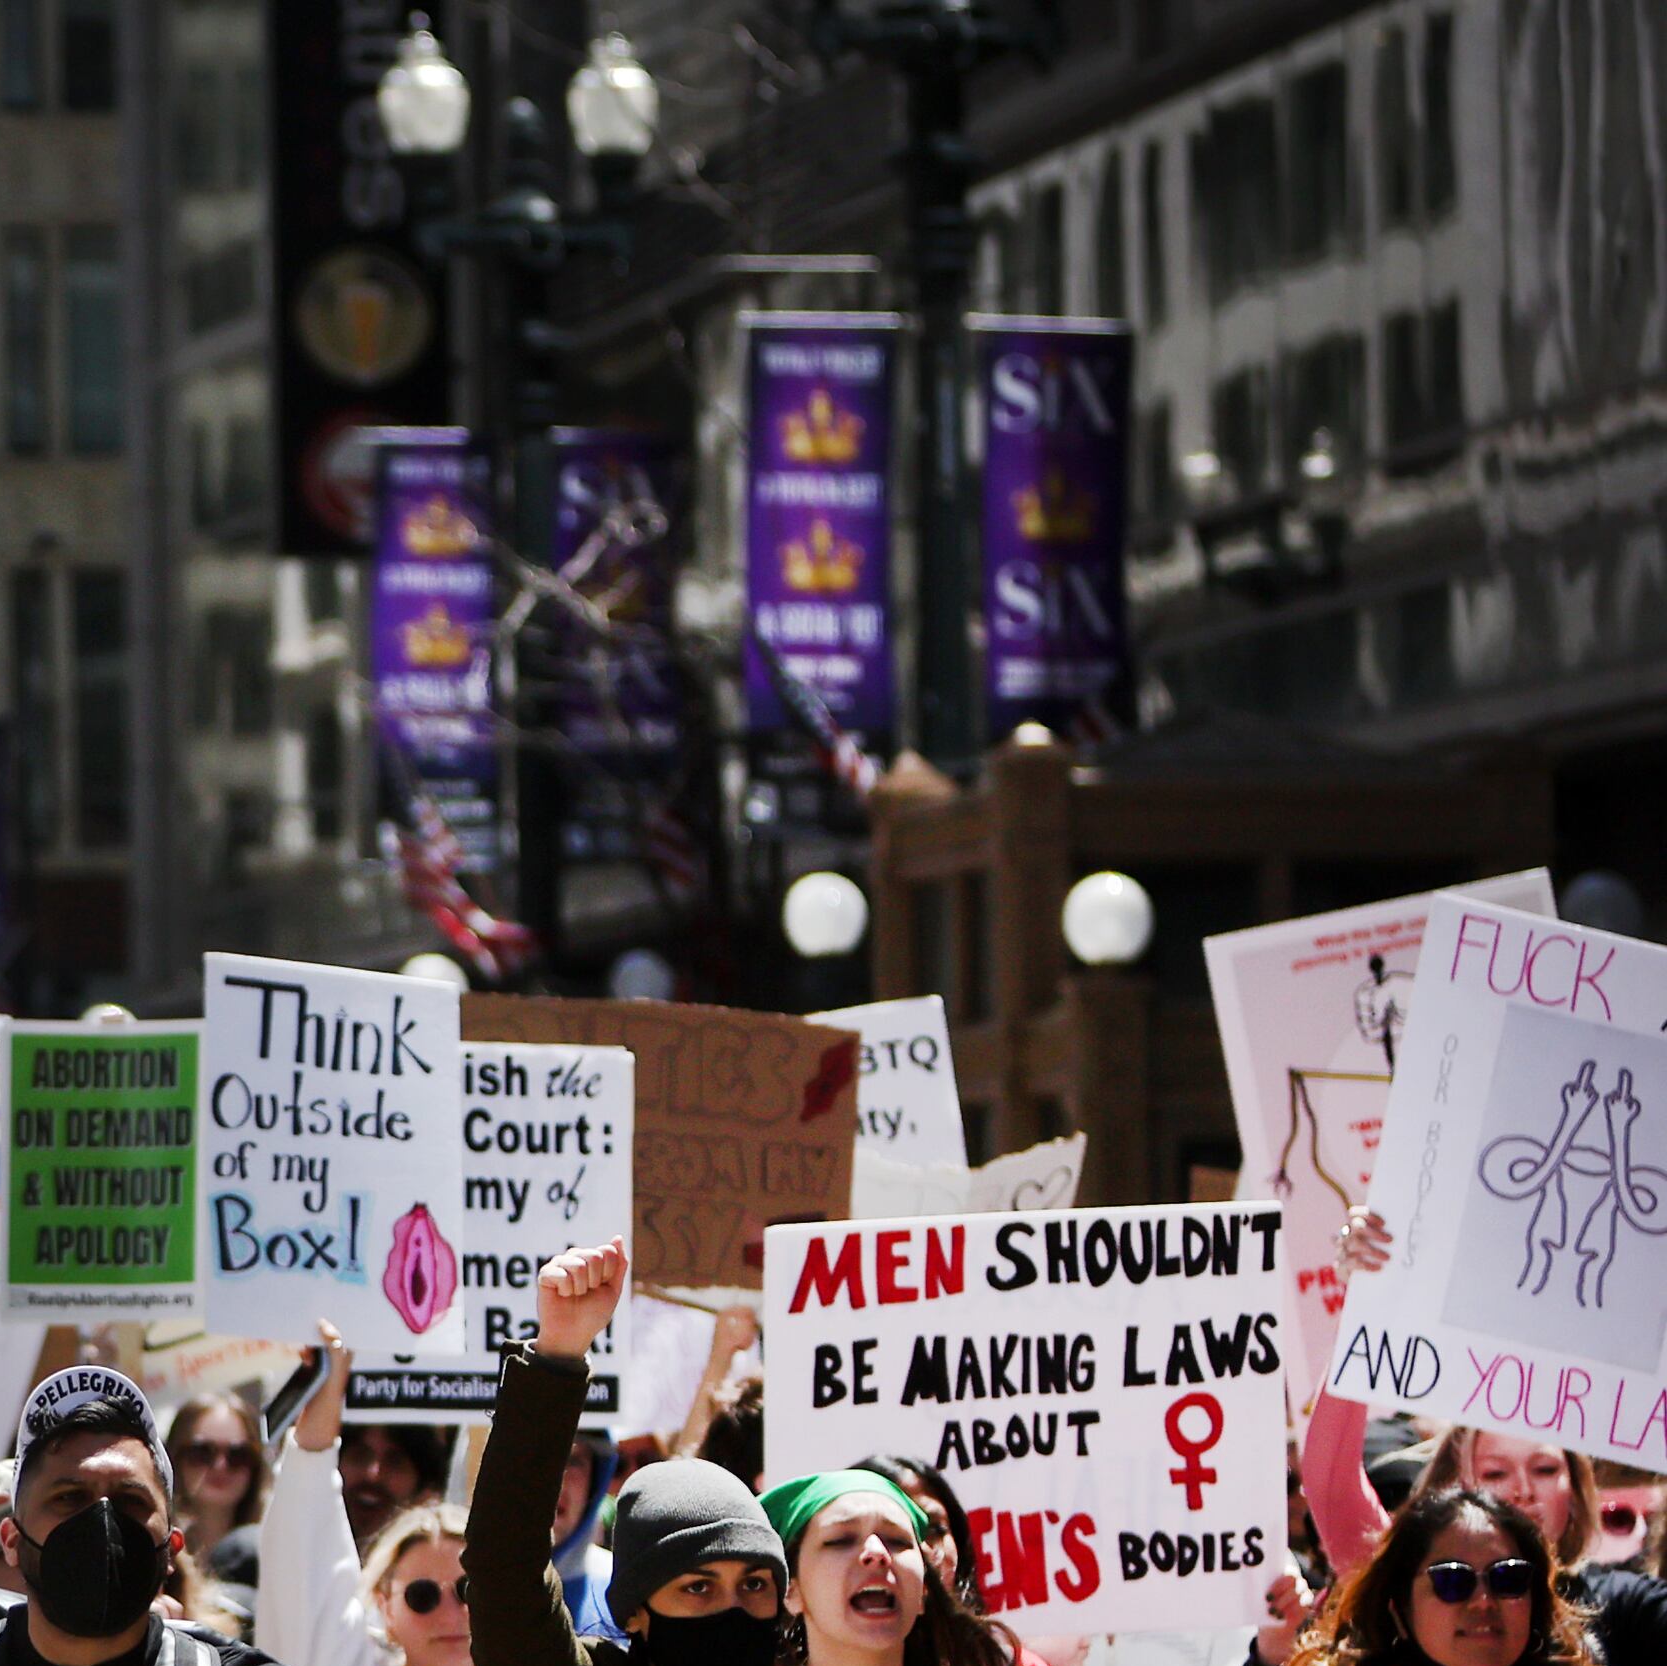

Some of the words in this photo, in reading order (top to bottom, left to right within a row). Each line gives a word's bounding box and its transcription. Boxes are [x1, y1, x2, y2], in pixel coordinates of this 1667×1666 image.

[1451, 913, 1616, 1021] FUCK
[224, 975, 433, 1076] Think
[31, 1049, 177, 1089] ABORTION
[545, 1056, 603, 1099] the
[17, 1109, 54, 1148] ON
[66, 1107, 193, 1148] DEMAND
[212, 1070, 414, 1141] Outside
[24, 1172, 43, 1207] &
[54, 1167, 185, 1207] WITHOUT
[214, 1141, 257, 1179] of
[272, 1153, 329, 1213] my
[547, 1164, 587, 1221] of
[35, 1225, 171, 1266] APOLOGY
[214, 1193, 361, 1273] Box!
[788, 1225, 965, 1314] MEN
[986, 1212, 1282, 1292] SHOULDN'T
[354, 1373, 398, 1403] Party
[403, 1375, 428, 1399] for
[812, 1339, 879, 1408] BE
[900, 1333, 1097, 1406] MAKING
[1123, 1313, 1281, 1387] LAWS
[1335, 1325, 1441, 1400] AND
[1462, 1347, 1592, 1441] YOUR
[936, 1410, 1100, 1470] ABOUT
[1119, 1527, 1265, 1581] BODIES
